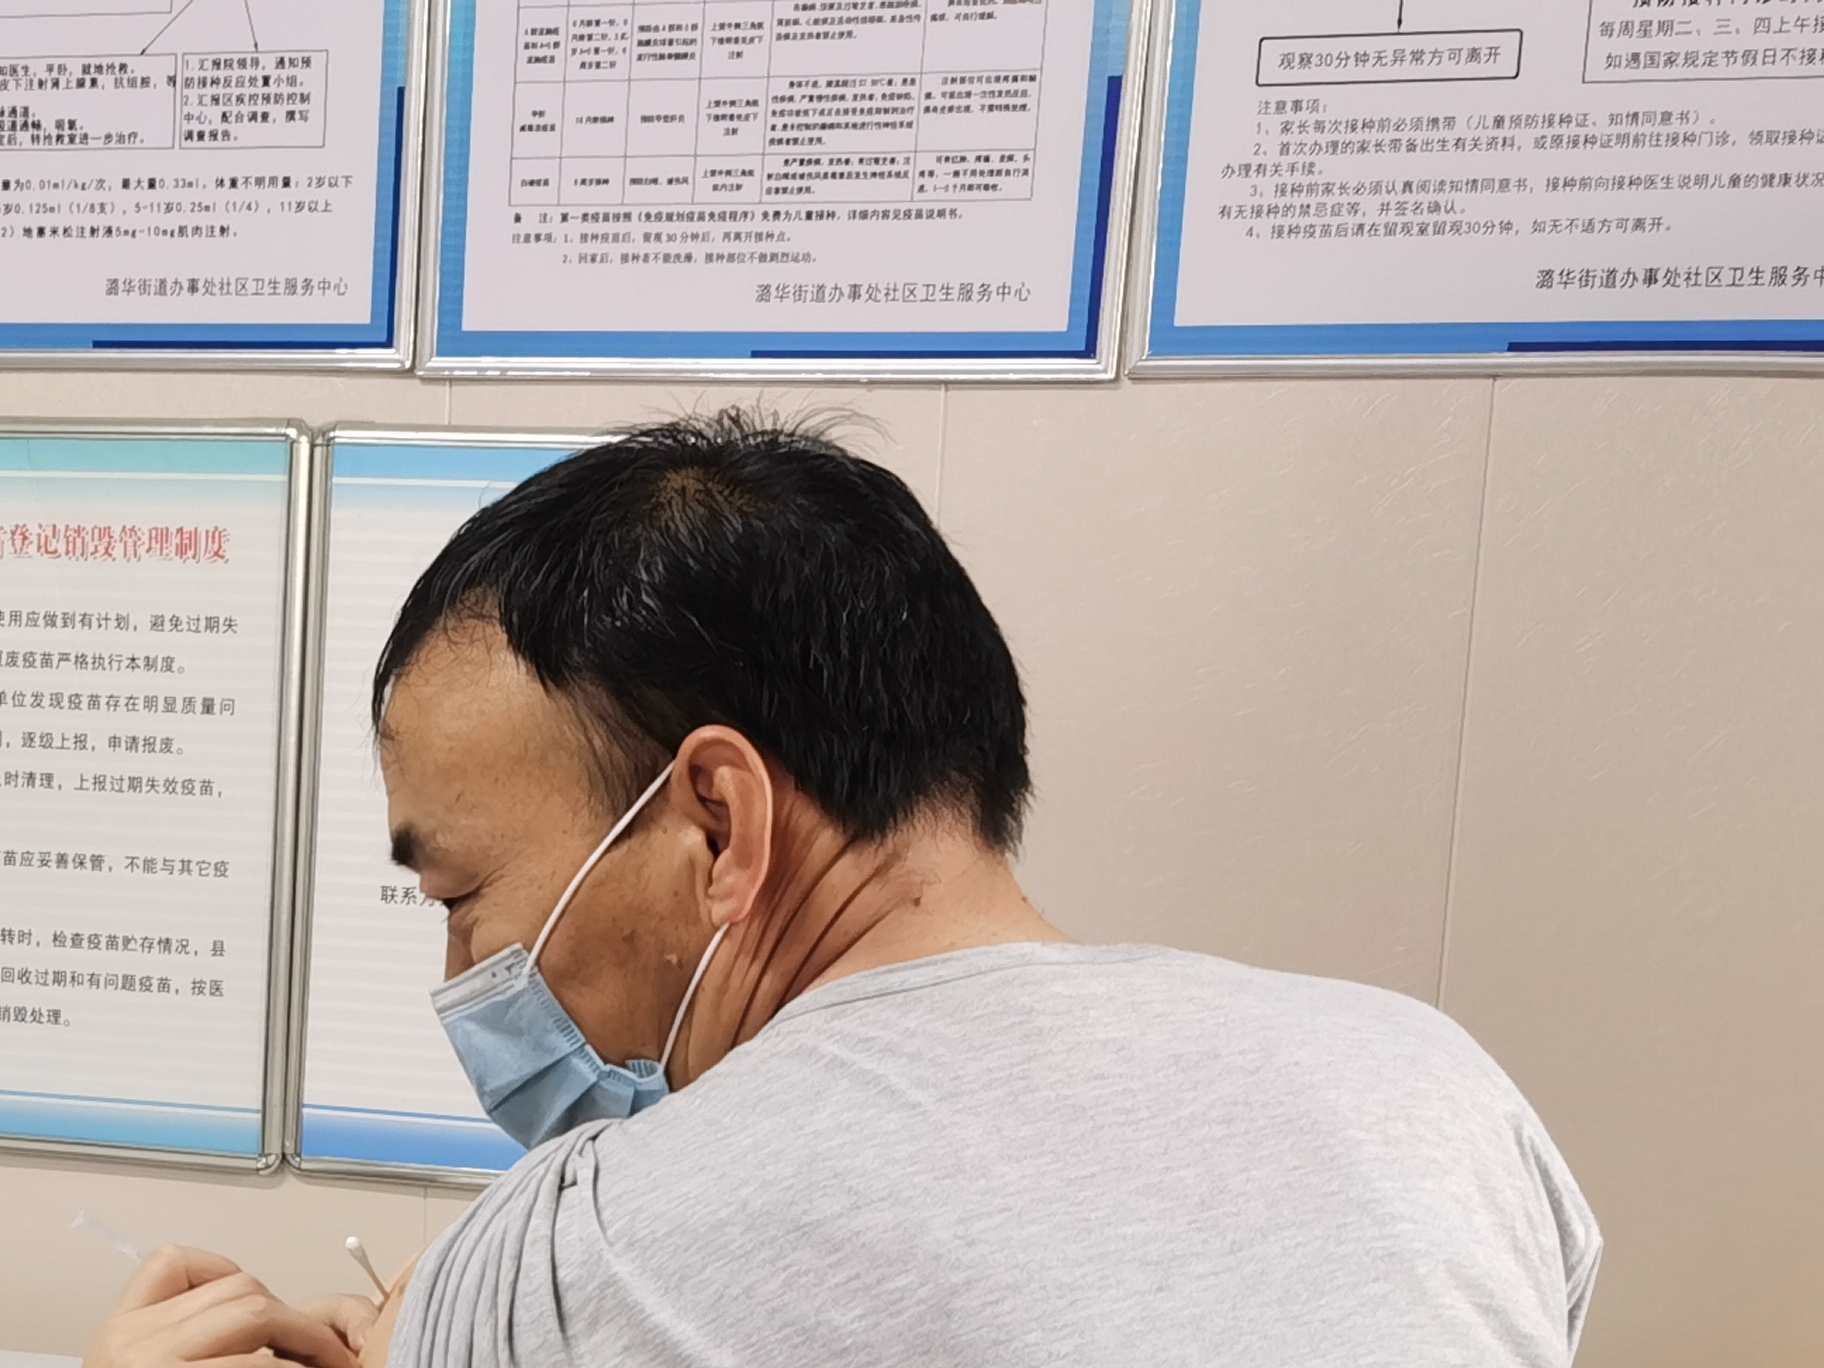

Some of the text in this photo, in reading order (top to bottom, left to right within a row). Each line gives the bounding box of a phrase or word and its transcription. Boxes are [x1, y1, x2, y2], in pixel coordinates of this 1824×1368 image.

[1277, 45, 1502, 71] 观察30分钟无异常方可离开
[1603, 46, 1824, 72] 如遇国家规定节假日不接
[1256, 98, 1328, 116] 注意事项：
[1220, 160, 1326, 180] 办理有关手续。
[105, 276, 349, 297] 潞华街道办事处社区卫生服务中心
[755, 281, 1031, 304] 潞华街道办事处社区卫生服务中心
